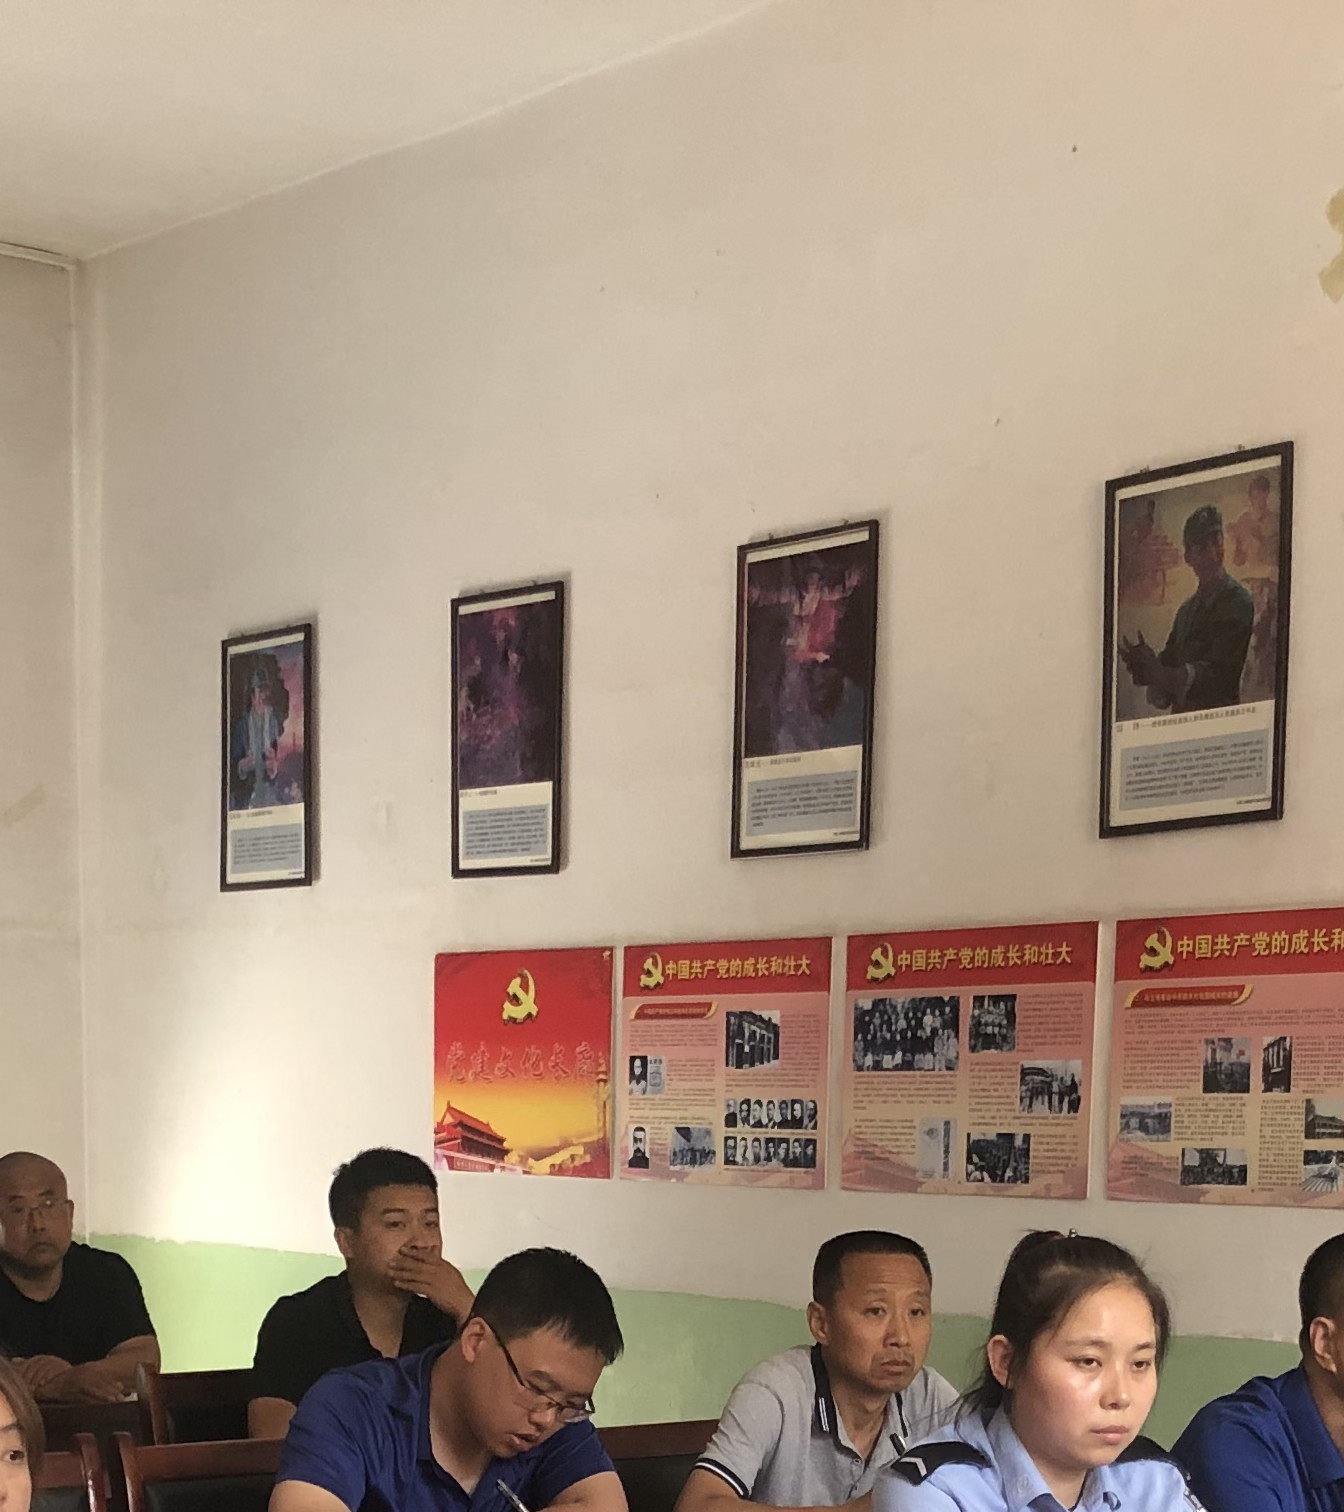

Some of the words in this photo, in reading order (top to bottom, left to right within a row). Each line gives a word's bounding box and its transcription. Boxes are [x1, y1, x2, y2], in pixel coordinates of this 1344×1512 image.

[665, 955, 811, 980] 中国共产党的成长和壮大
[897, 941, 1072, 972] 中国共产党的成长和壮大
